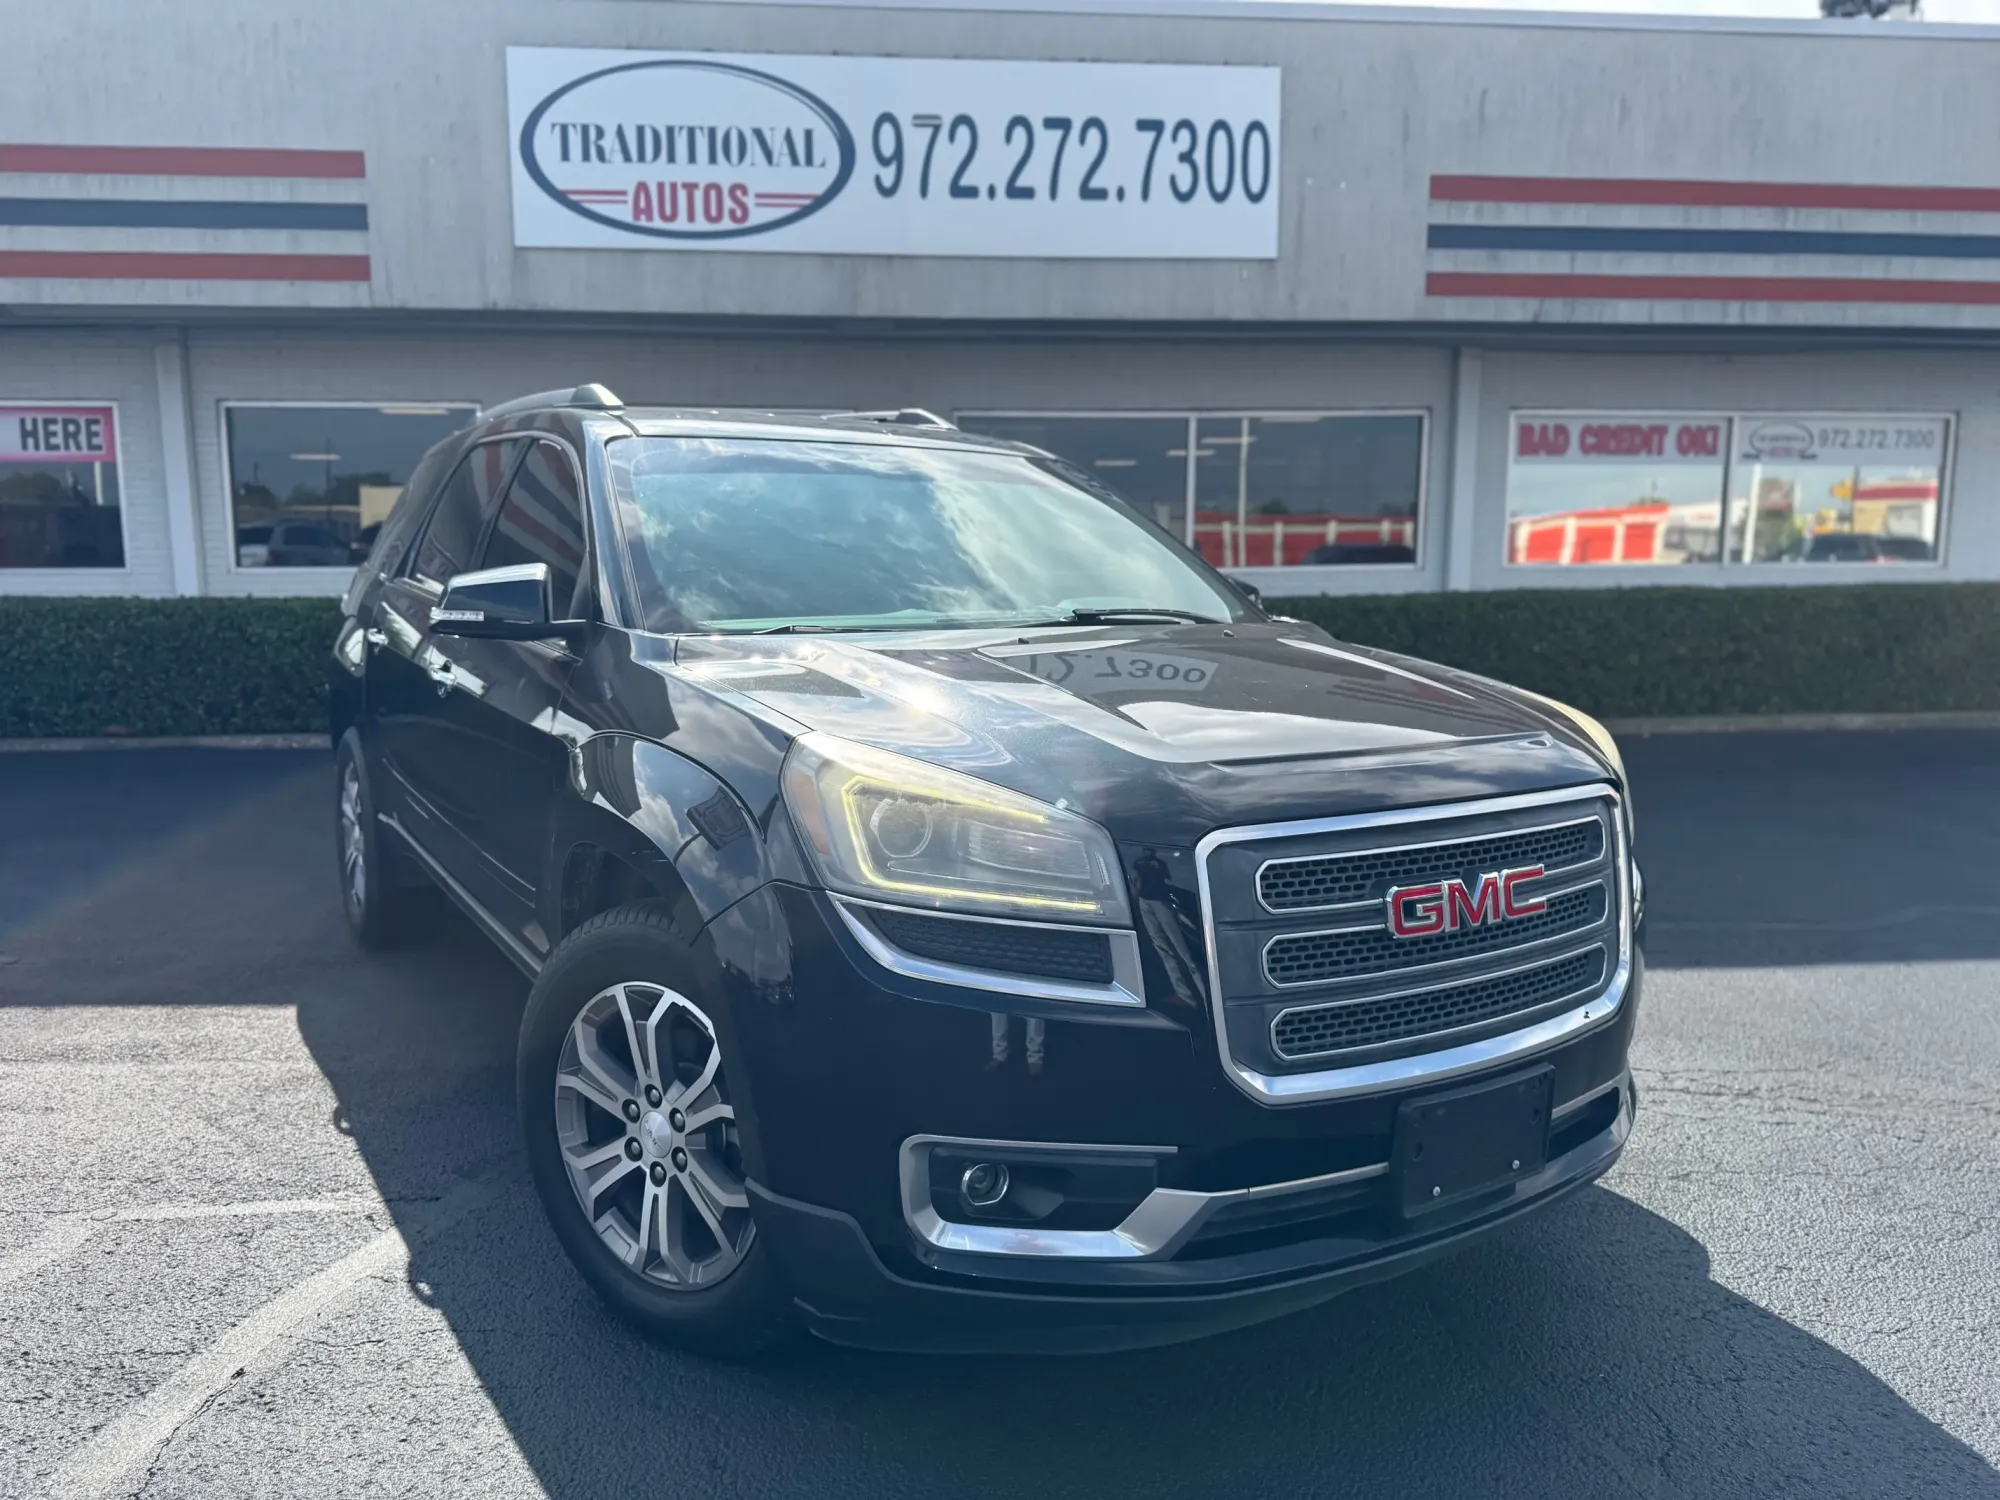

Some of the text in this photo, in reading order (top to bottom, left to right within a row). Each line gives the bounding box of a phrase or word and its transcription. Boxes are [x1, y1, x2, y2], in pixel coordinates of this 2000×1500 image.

[551, 122, 826, 168] TRADITIONAL
[871, 111, 1270, 204] 972.272.7300
[632, 180, 749, 225] AUTOS
[19, 416, 103, 452] HERE
[1386, 865, 1547, 939] GMC
